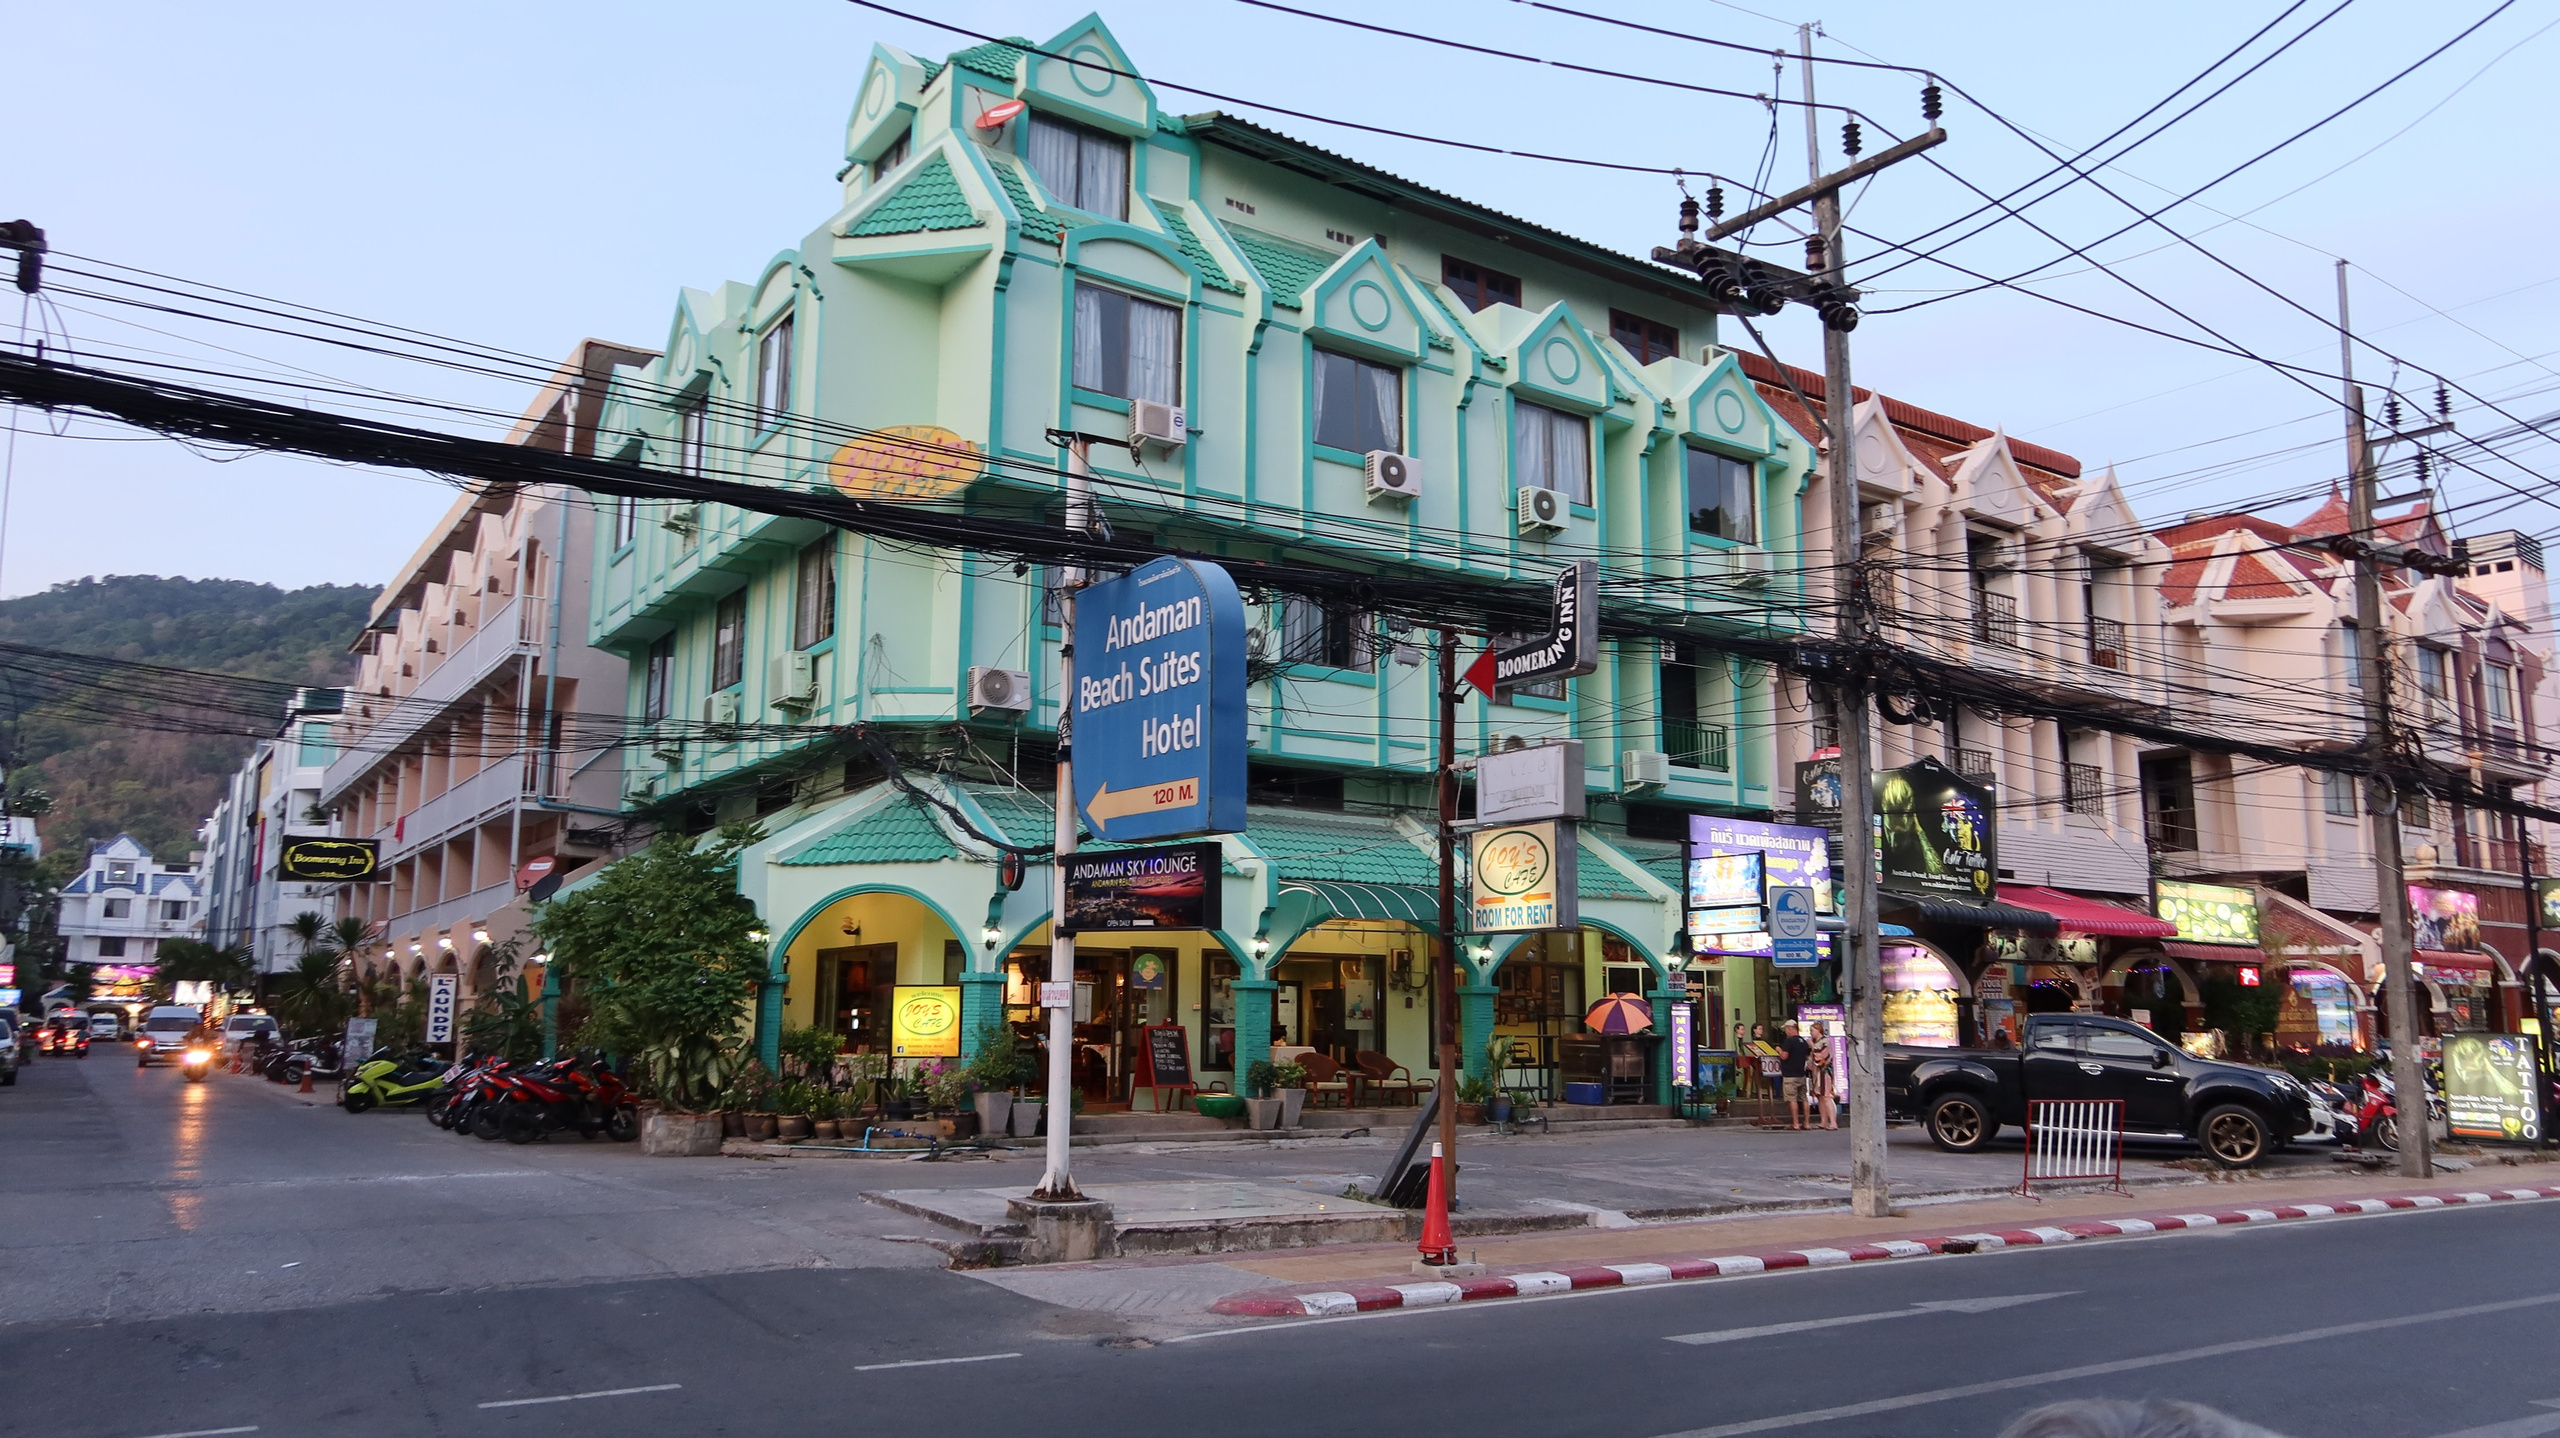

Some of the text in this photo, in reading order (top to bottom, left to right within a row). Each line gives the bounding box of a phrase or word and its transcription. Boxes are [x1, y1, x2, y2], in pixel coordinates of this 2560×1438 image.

[1105, 595, 1200, 653] Andaman
[1498, 586, 1575, 679] BOOMERANG INN
[1080, 650, 1200, 713] Beach Suites
[1142, 704, 1200, 759] Hotel
[1153, 784, 1194, 805] 120 M.
[1710, 827, 1811, 855] กินรี นวดเพื่อสุขภาพ
[293, 853, 366, 866] Boomerang Inn
[1073, 856, 1197, 880] ANDAMAN SKY LOUNGE
[1486, 841, 1538, 871] JOY'S
[1091, 879, 1118, 888] ANDAMAN
[1119, 878, 1136, 887] BEACH
[1136, 876, 1155, 885] SUITES
[1156, 876, 1174, 885] HOTEL
[1892, 869, 1912, 877] Australian
[1941, 873, 1958, 883] Winning
[1107, 919, 1131, 927] OPEN DAILY
[1476, 904, 1553, 928] ROOM FOR RENT
[1717, 908, 1760, 918] AIR TICKET
[911, 990, 944, 998] welcome
[432, 979, 450, 1041] LAUNDRY
[905, 1004, 941, 1018] JOY'S
[1675, 1016, 1688, 1083] MASSAGE
[2449, 1093, 2503, 1103] Australian Owned
[2514, 1037, 2538, 1140] TATTOO
[2449, 1101, 2470, 1109] Award
[2471, 1101, 2498, 1112] Winning
